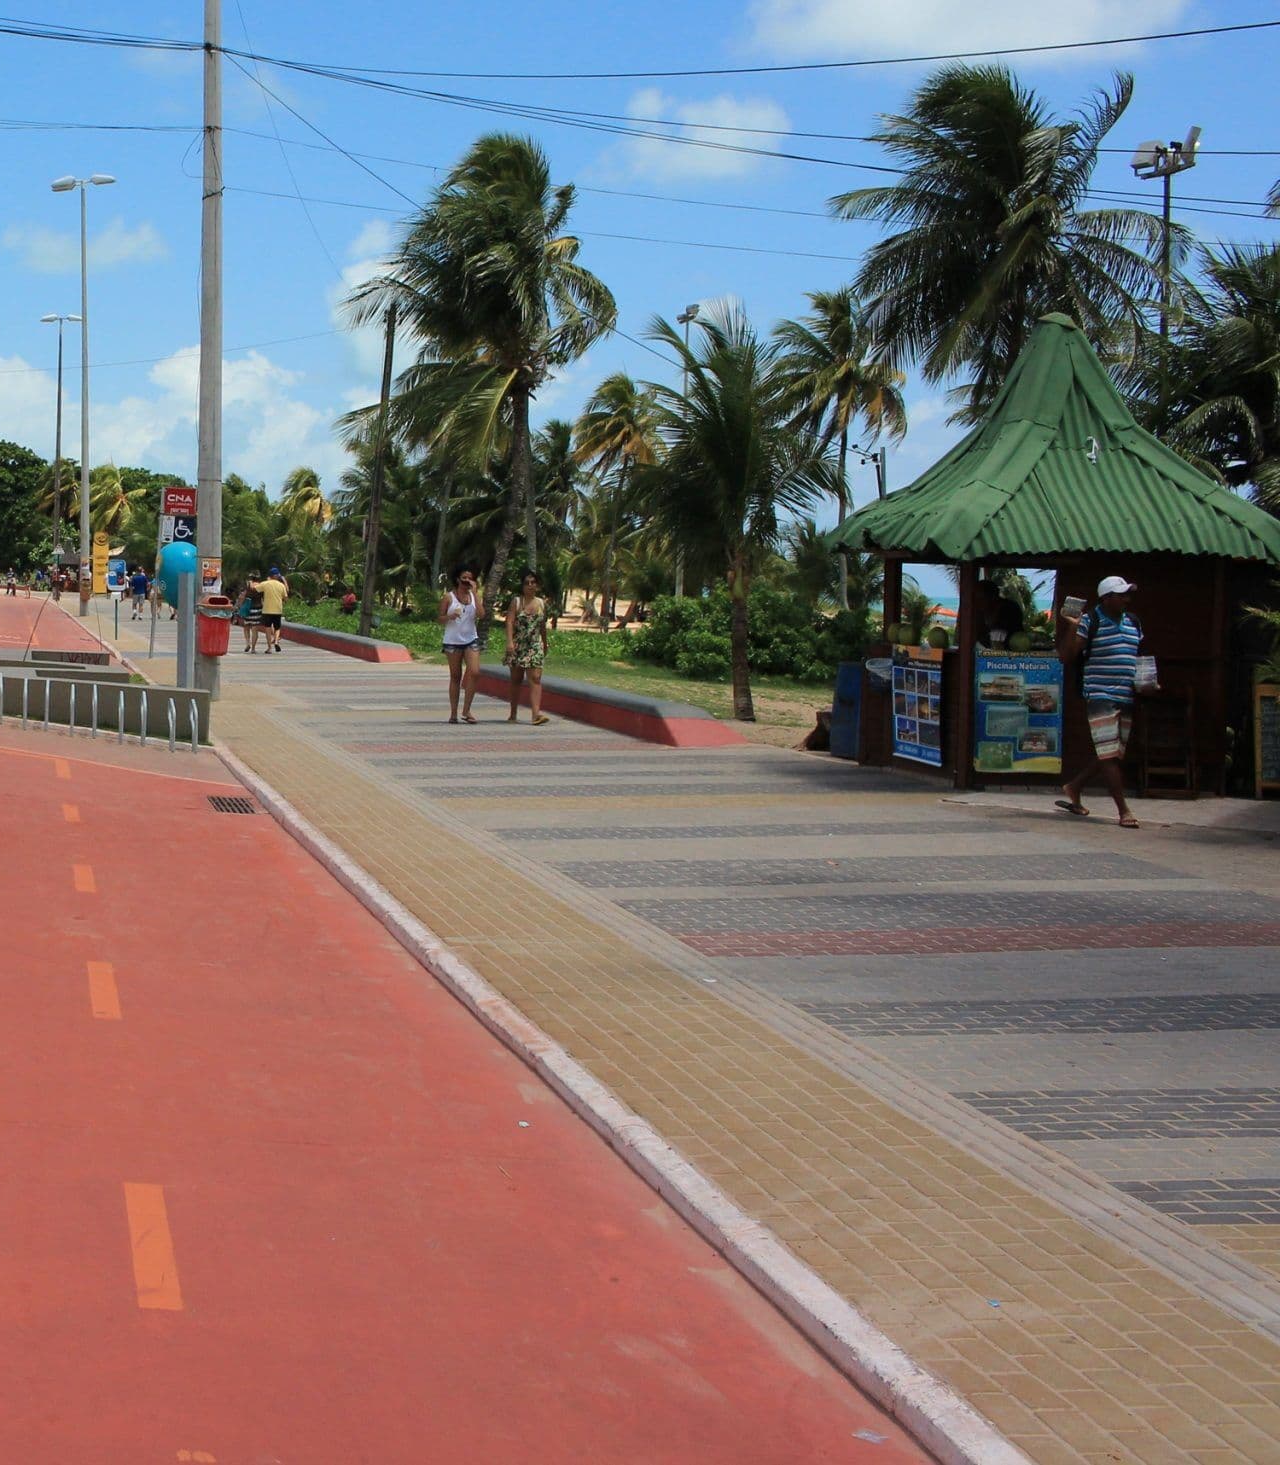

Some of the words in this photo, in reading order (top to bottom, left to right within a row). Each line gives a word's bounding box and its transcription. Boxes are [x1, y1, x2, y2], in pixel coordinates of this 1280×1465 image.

[167, 494, 193, 503] CNA
[986, 661, 1017, 670] Piscinas
[1019, 662, 1050, 670] Naturais
